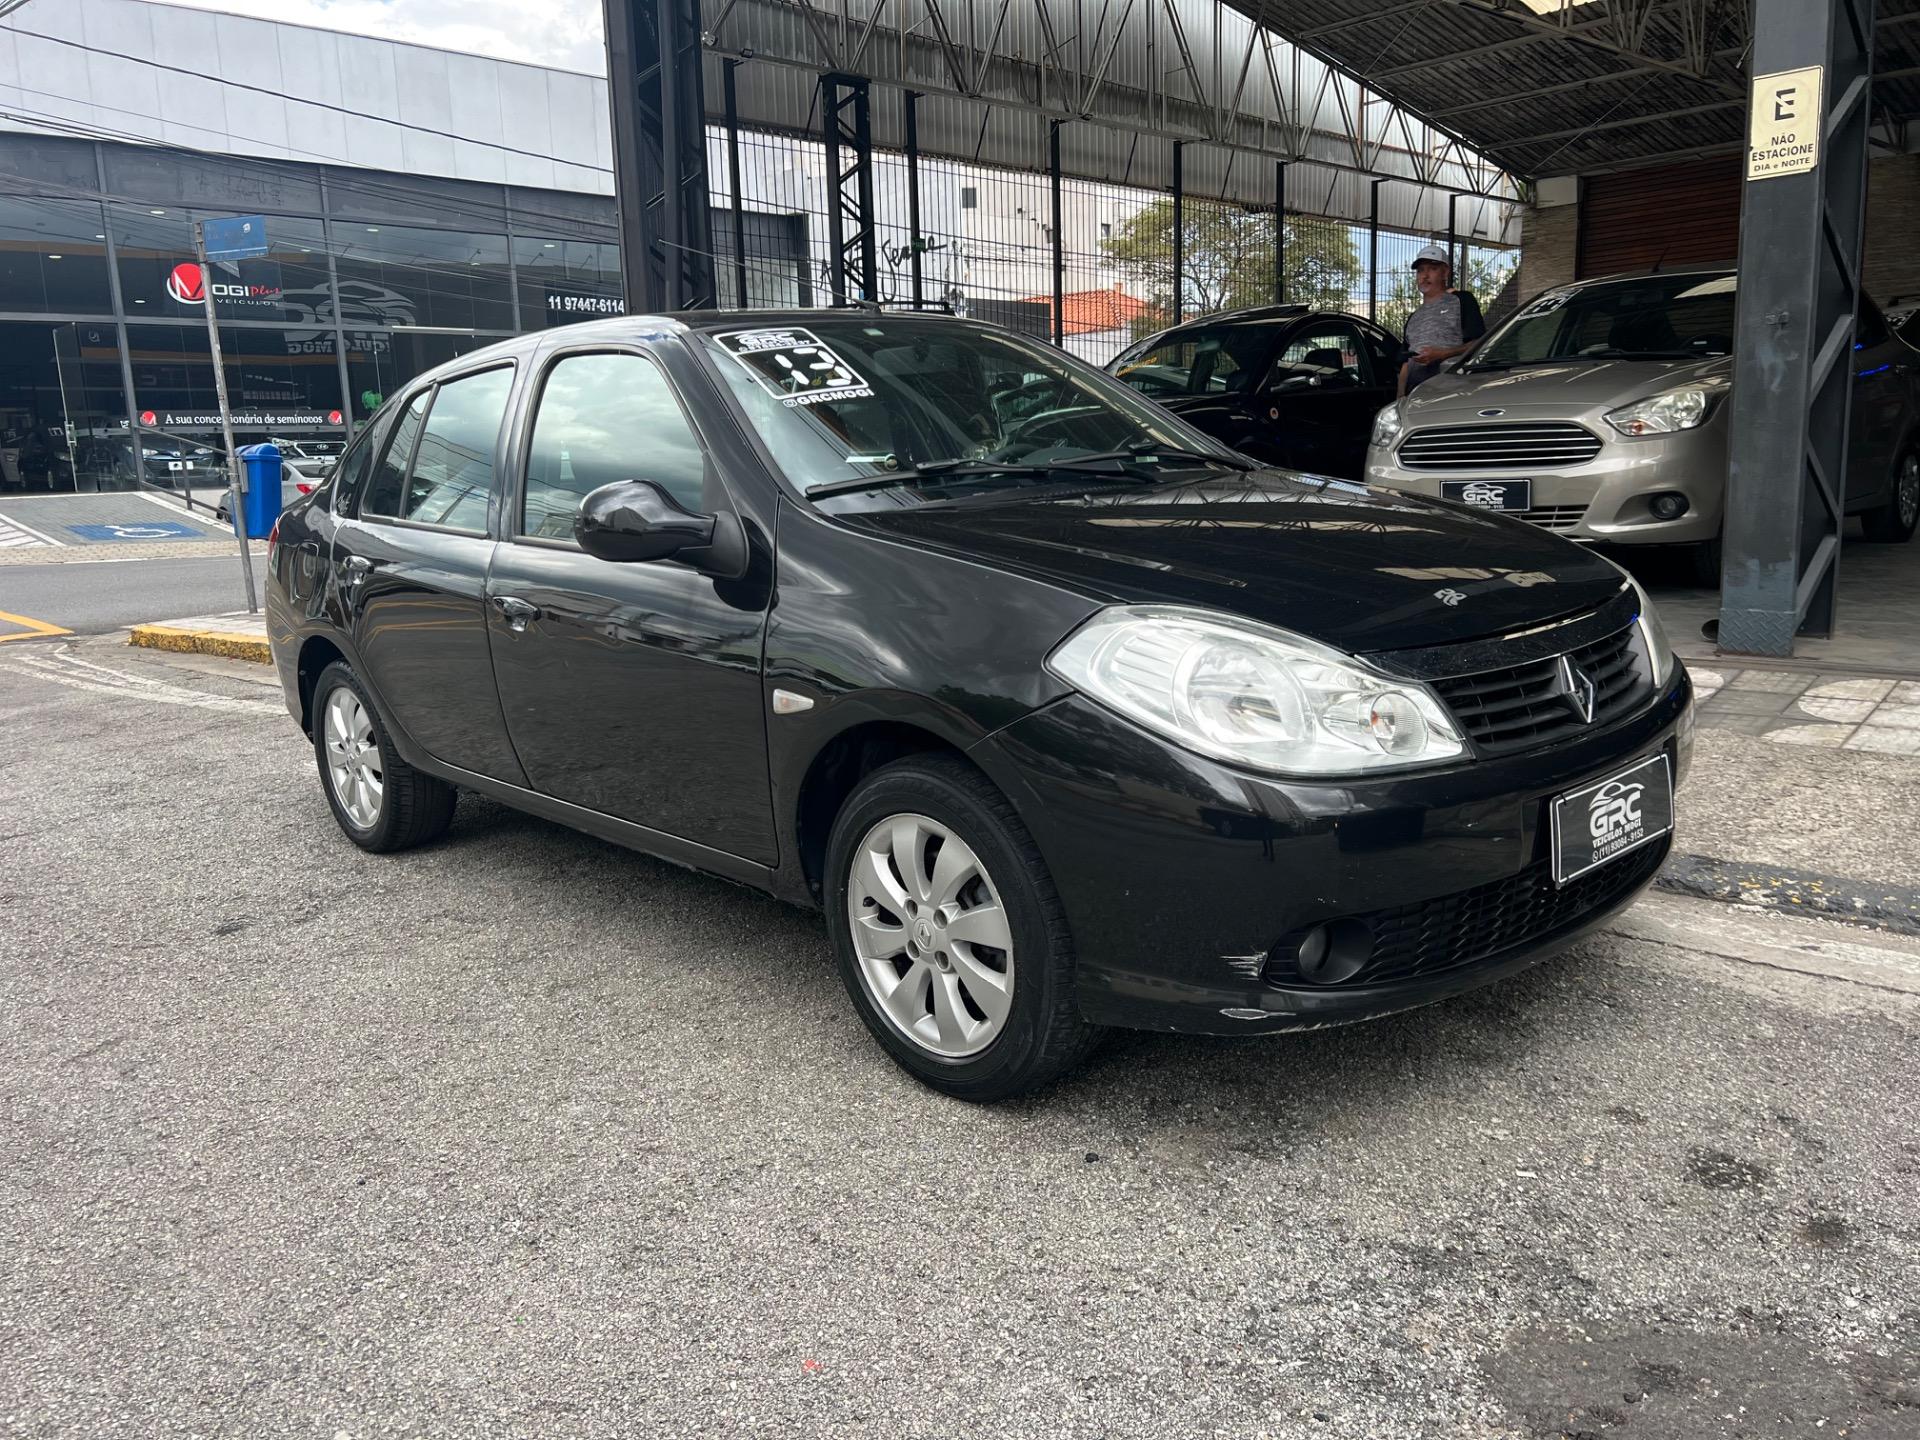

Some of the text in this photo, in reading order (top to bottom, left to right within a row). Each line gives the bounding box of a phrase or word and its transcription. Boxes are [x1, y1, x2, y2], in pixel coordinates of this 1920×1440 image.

[1771, 132, 1796, 146] NÃO
[1752, 143, 1814, 162] ESTACIONE
[1754, 163, 1771, 172] DIA
[1781, 156, 1811, 168] NOITE
[548, 295, 625, 313] 11 97447-6114
[774, 347, 853, 386] 13
[165, 413, 174, 425] A
[175, 416, 193, 425] sua
[194, 413, 263, 425] conceionária
[264, 413, 275, 424] de
[1462, 489, 1504, 502] GRC
[1590, 790, 1642, 838] GRC
[1592, 817, 1641, 849] VEICULOS MOGI
